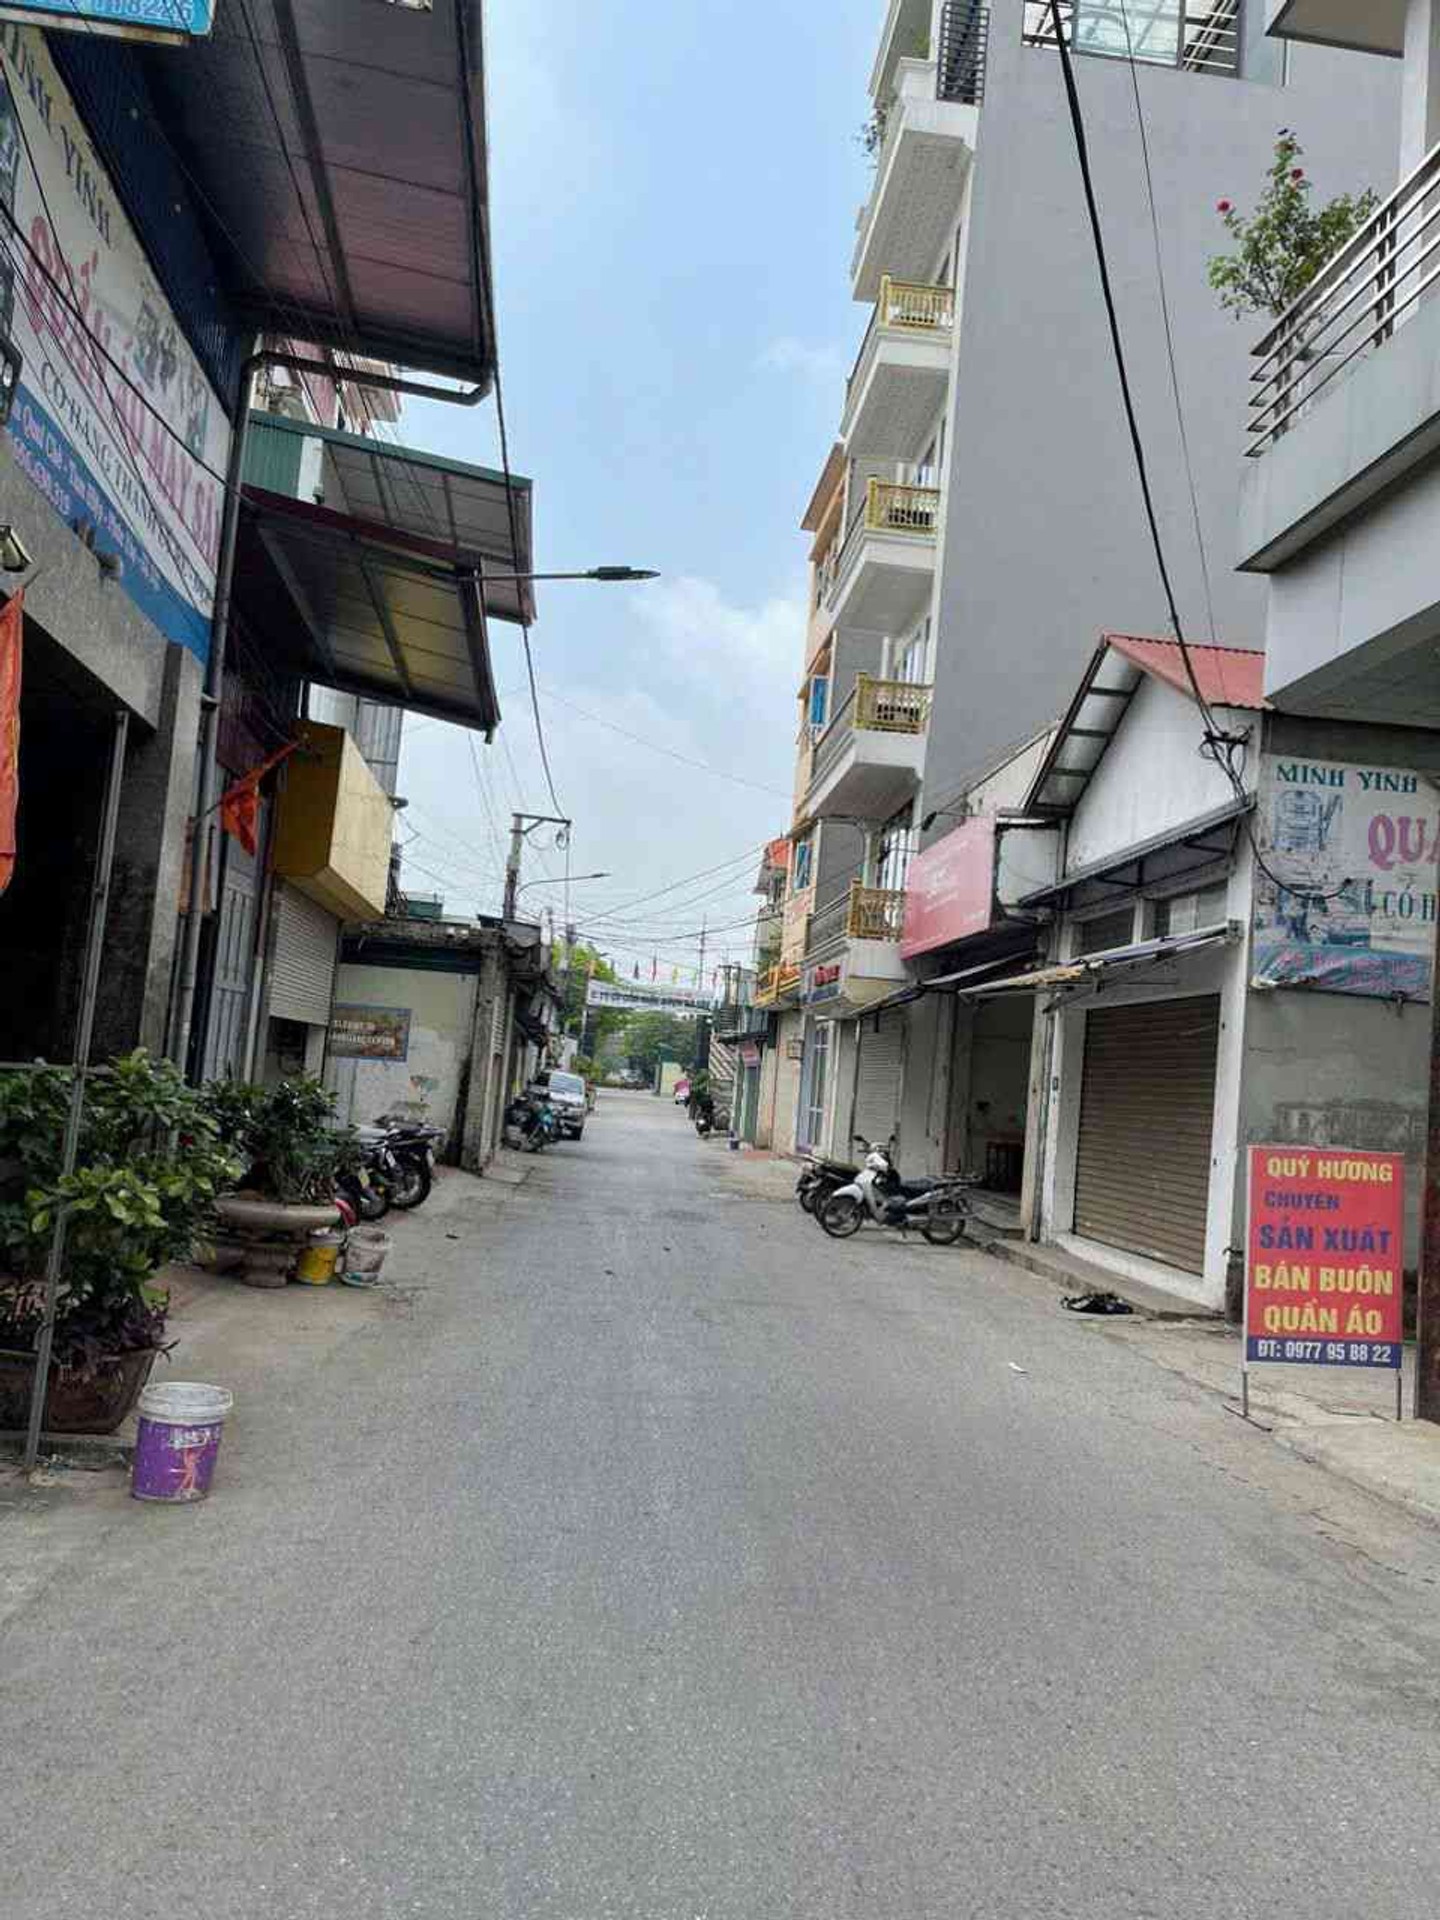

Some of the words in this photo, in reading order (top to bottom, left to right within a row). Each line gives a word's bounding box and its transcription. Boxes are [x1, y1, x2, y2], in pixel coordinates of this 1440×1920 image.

[1276, 764, 1344, 787] MINH
[1356, 771, 1418, 793] YINH
[1317, 1158, 1393, 1182] HƯƠNG
[1255, 1260, 1311, 1290] BÁN
[1318, 1265, 1393, 1294] BUÔN
[1264, 1298, 1339, 1333] QUẦN
[1346, 1303, 1383, 1334] ÁO
[1284, 1341, 1322, 1360] 0977
[1372, 1345, 1392, 1363] 22
